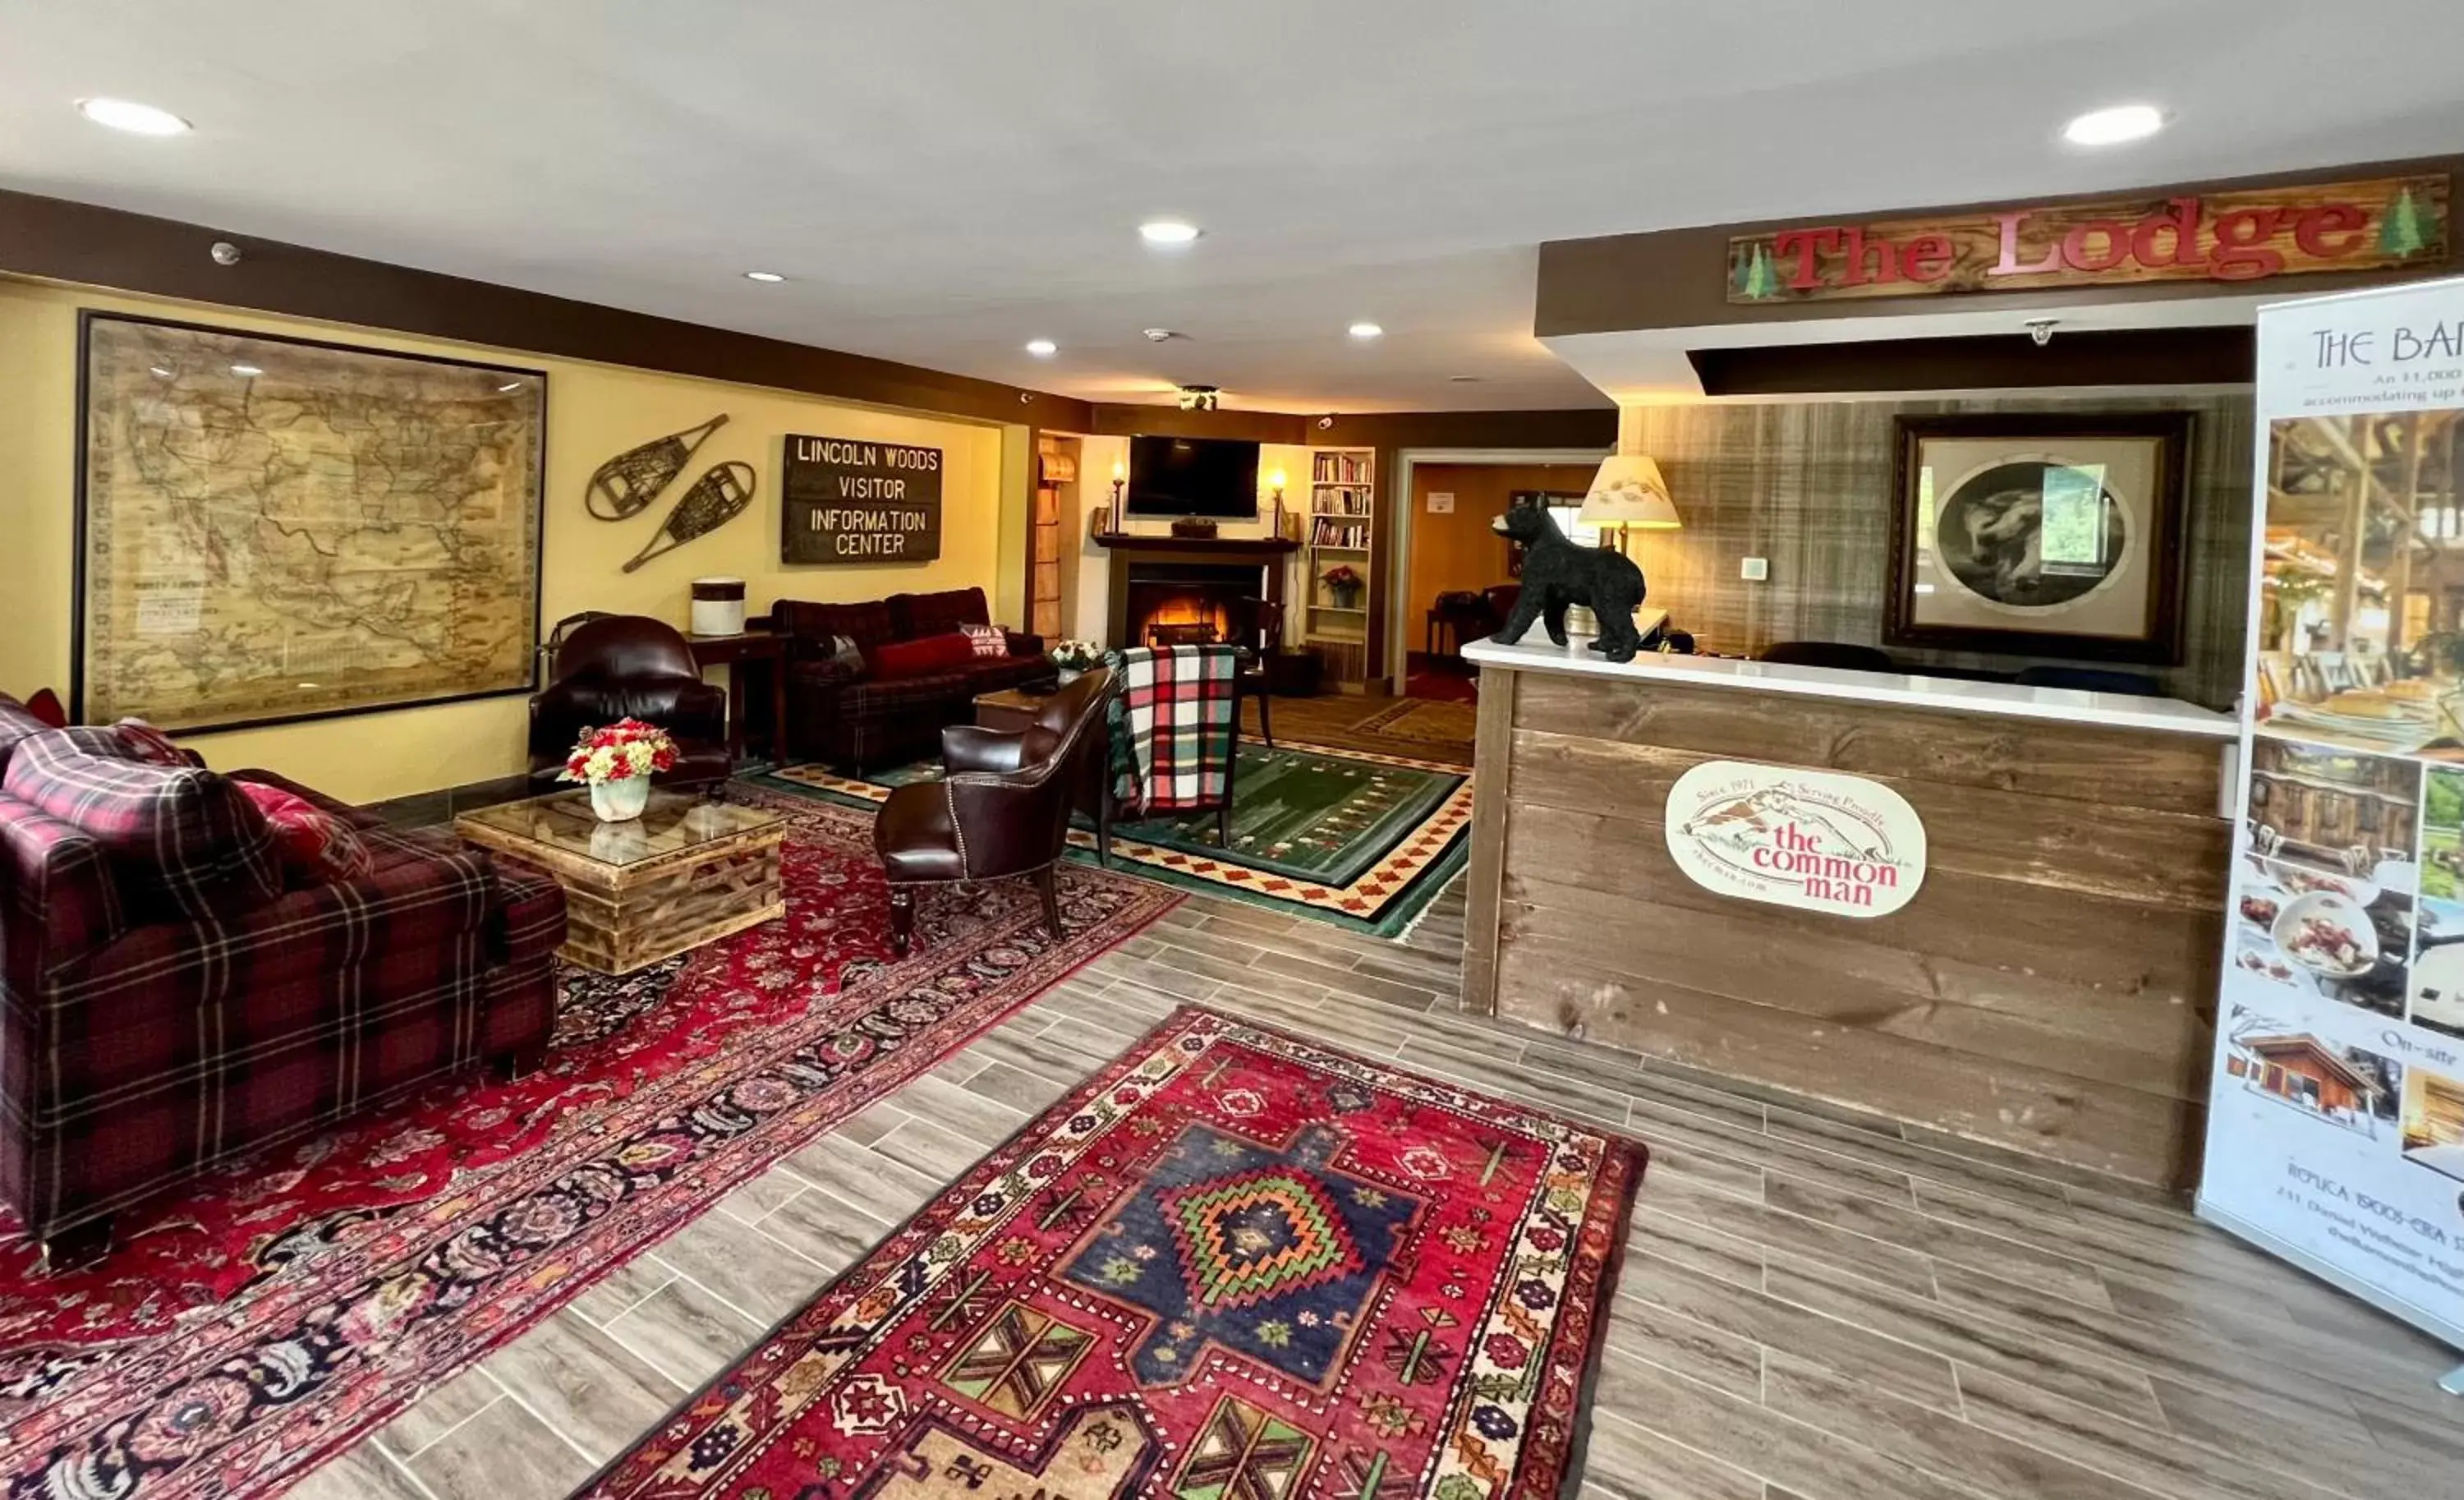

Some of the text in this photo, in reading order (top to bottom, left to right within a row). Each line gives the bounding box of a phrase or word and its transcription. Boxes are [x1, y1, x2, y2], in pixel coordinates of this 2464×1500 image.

[1776, 196, 2369, 288] The Lodge
[2313, 329, 2374, 368] THE
[2432, 388, 2456, 401] up
[798, 438, 938, 471] LINCOLN WOODS
[839, 476, 906, 500] VISITOR
[811, 508, 926, 531] INFORMATION
[836, 534, 905, 555] CENTER
[1774, 821, 1823, 855] the
[1753, 847, 1897, 887] common
[1804, 876, 1873, 906] man
